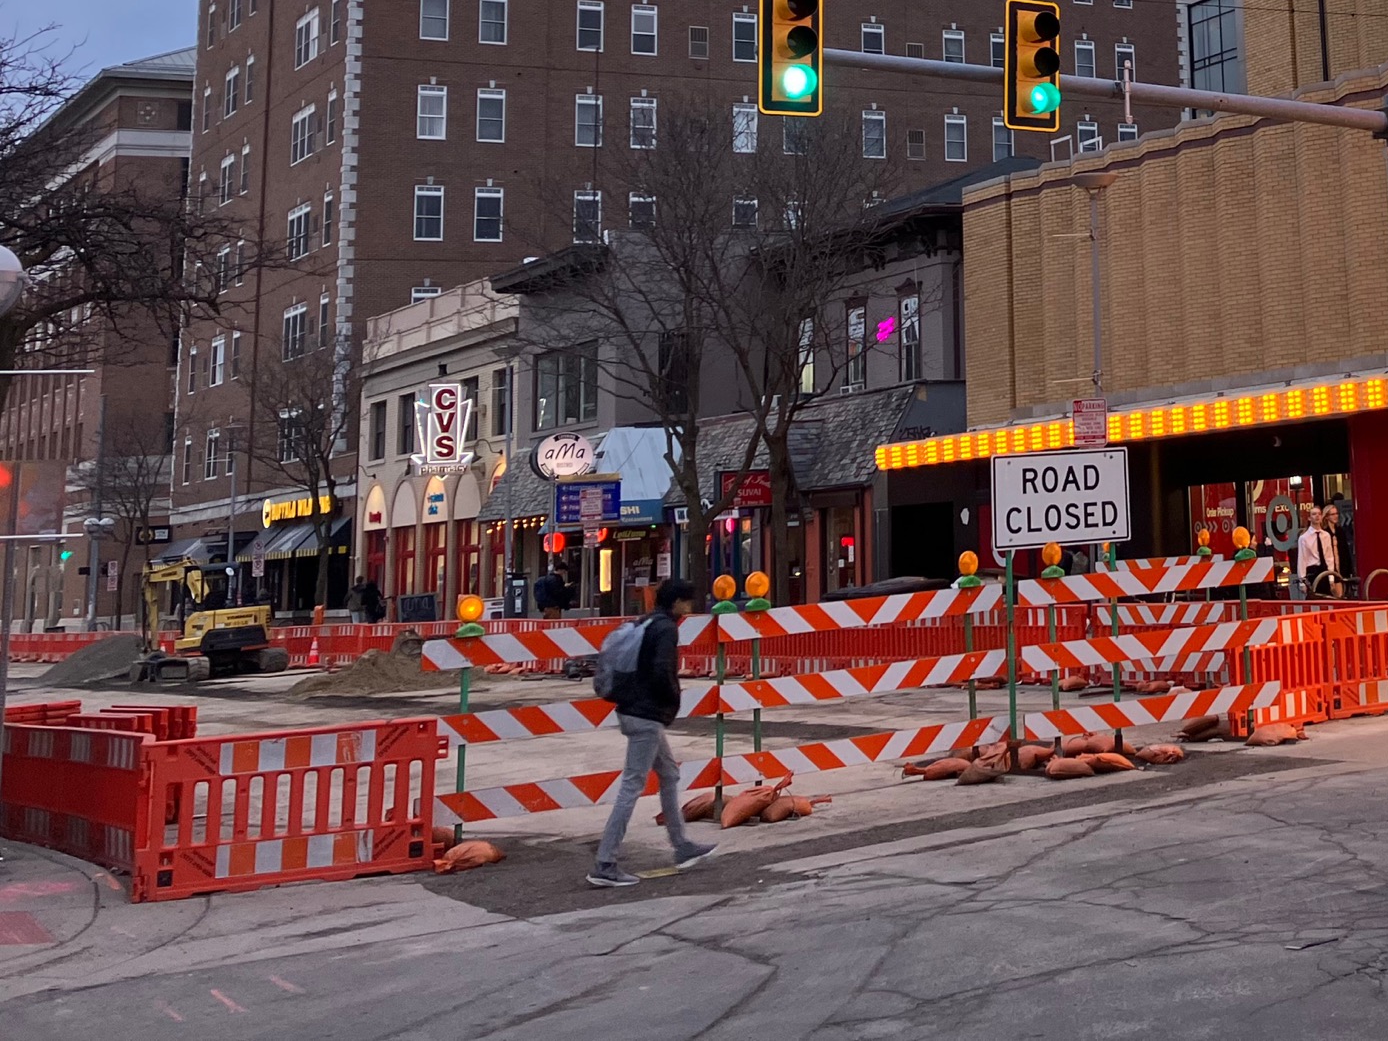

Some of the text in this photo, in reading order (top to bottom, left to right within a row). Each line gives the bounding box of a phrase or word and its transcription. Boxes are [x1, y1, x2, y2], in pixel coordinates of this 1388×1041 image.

[1082, 402, 1105, 410] PARKING
[434, 388, 457, 458] CVS
[420, 465, 468, 475] pharmacy
[1022, 464, 1100, 494] ROAD
[1006, 501, 1118, 534] CLOSED
